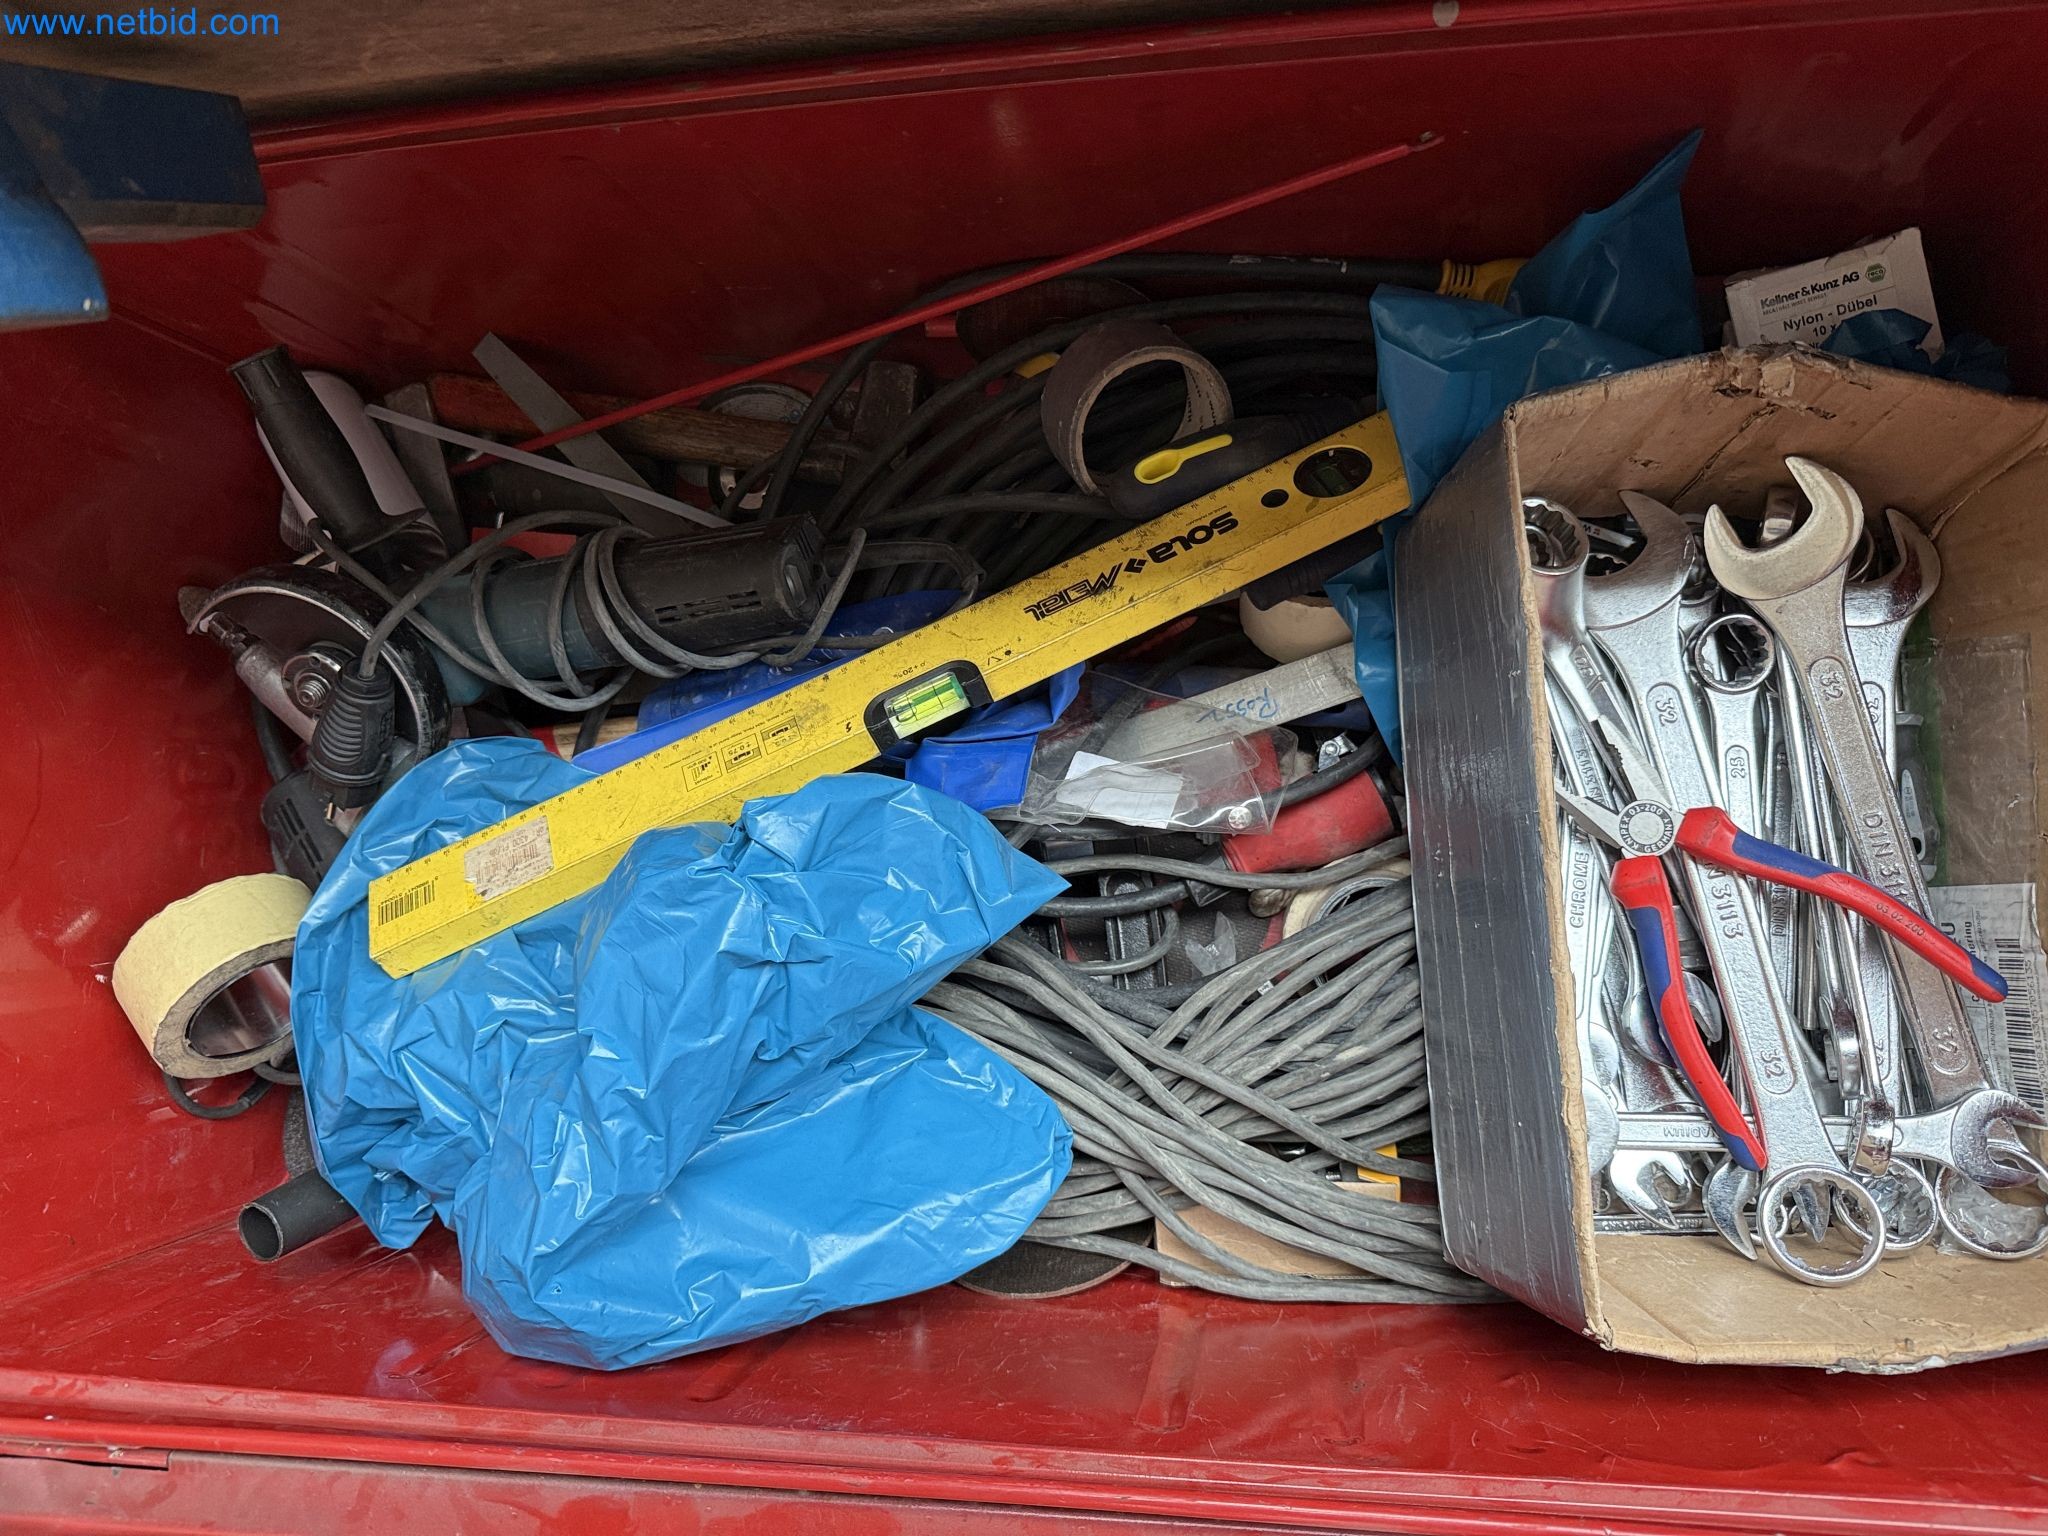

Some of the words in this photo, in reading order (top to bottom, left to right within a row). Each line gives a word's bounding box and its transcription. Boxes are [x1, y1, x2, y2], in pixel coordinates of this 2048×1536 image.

[1842, 271, 1860, 286] AG
[1783, 311, 1824, 332] Nylon
[1836, 294, 1878, 316] Dübel
[1812, 325, 1827, 338] 10
[1819, 673, 1844, 700] 32
[1655, 697, 1678, 725] 32
[1620, 815, 1639, 849] KNIPEX
[1643, 817, 1672, 852] GERMANY
[1862, 811, 1894, 860] DIN
[1569, 852, 1590, 929] CHROME
[1758, 1049, 1786, 1079] 32
